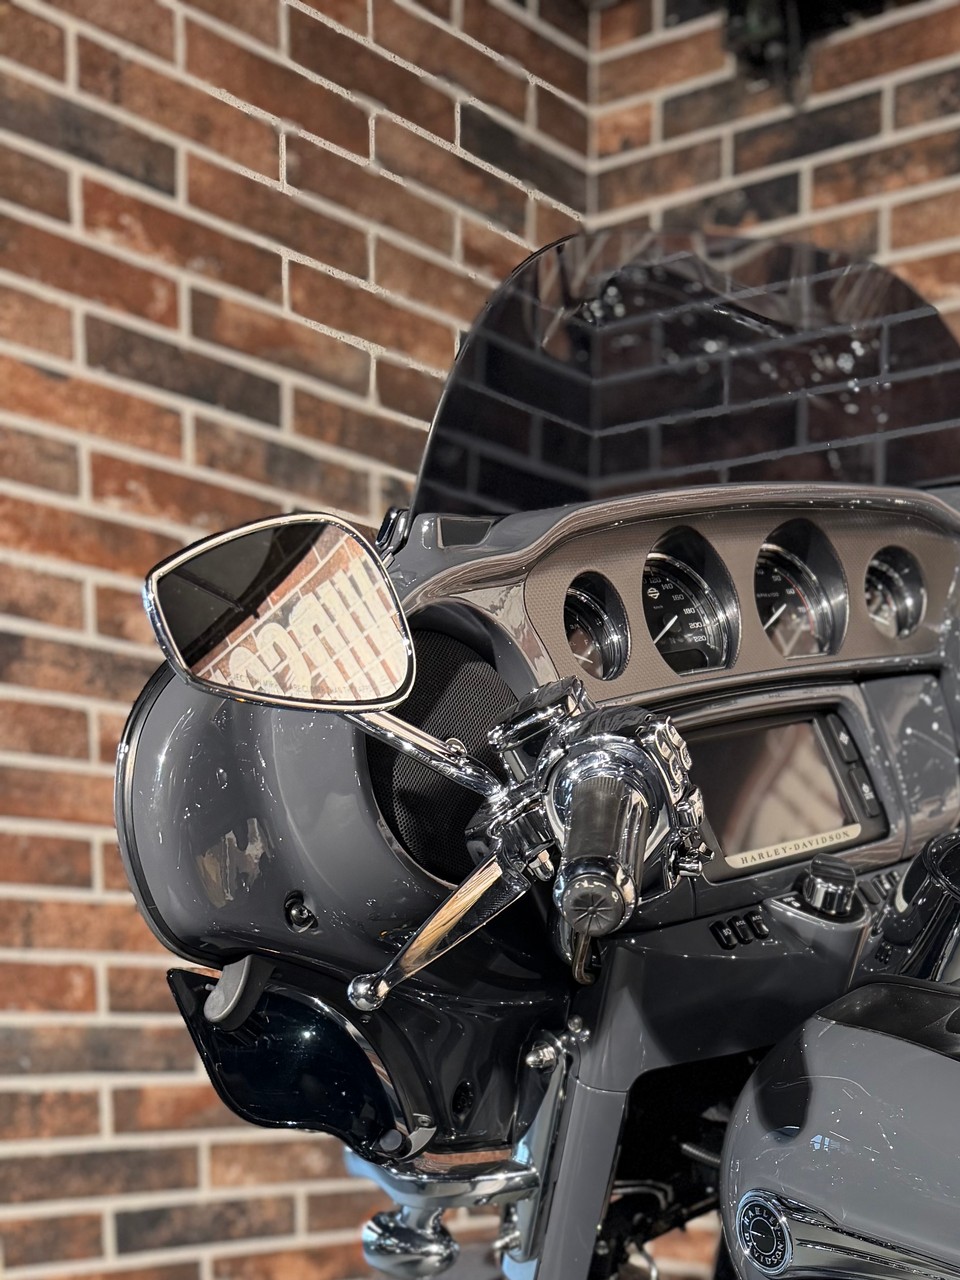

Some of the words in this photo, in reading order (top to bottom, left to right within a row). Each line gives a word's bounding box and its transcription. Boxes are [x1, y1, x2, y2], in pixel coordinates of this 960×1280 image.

[683, 607, 696, 615] 180
[688, 621, 703, 629] 200
[741, 830, 851, 864] HARLEY-DAVIDSON
